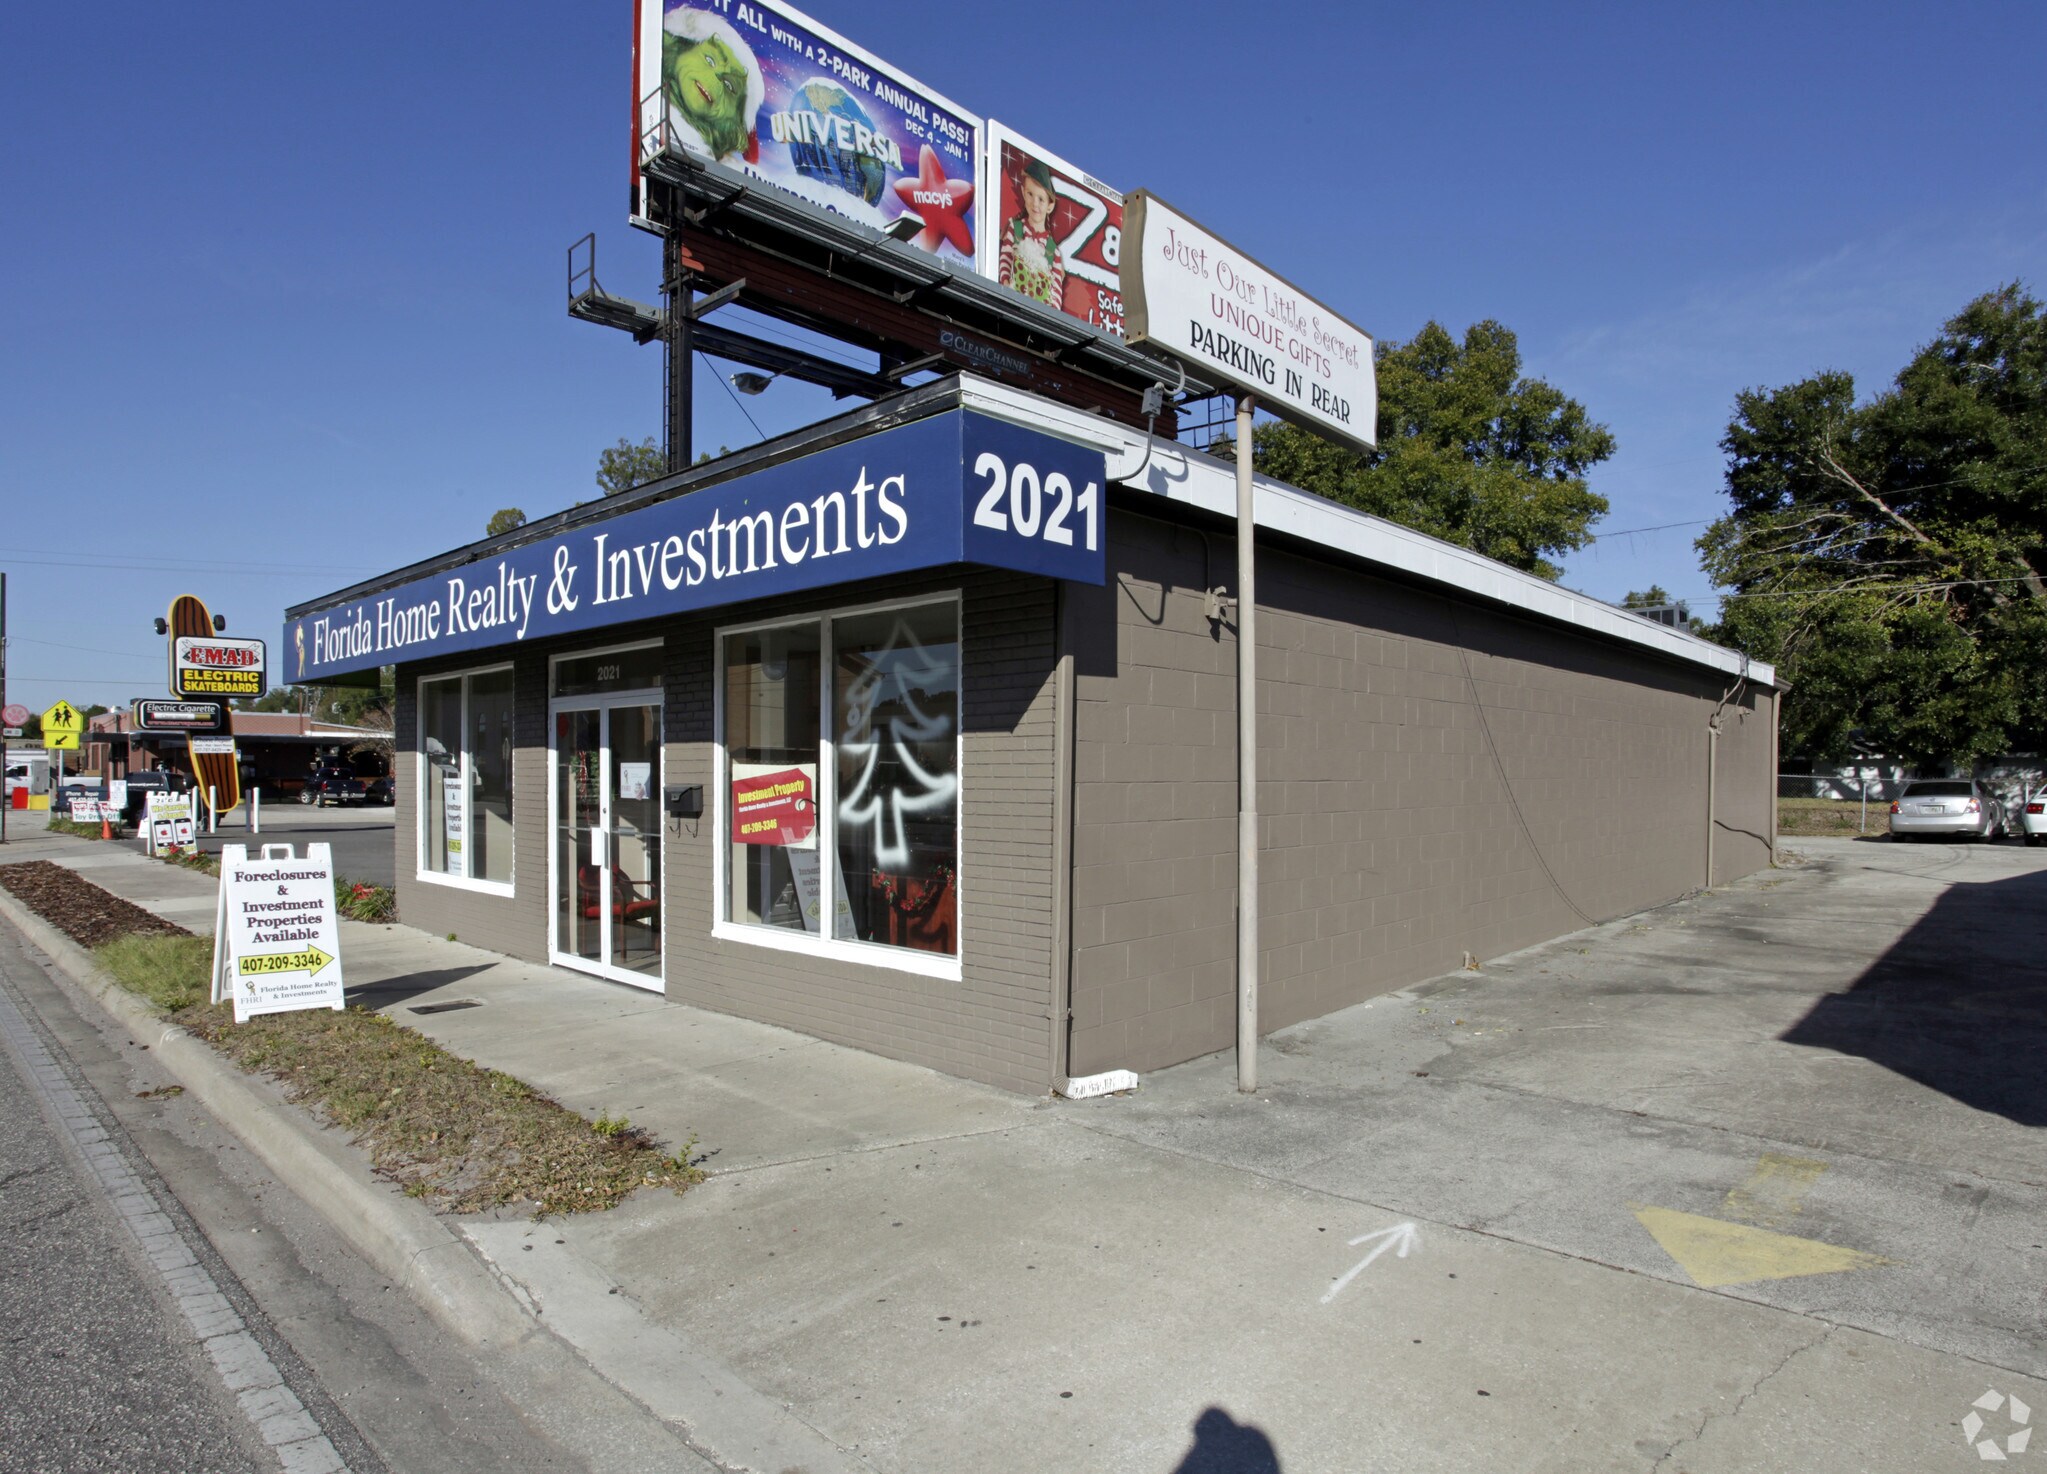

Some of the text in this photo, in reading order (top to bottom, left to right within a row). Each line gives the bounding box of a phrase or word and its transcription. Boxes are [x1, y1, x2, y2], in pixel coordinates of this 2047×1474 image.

[737, 2, 767, 34] ALL
[771, 24, 802, 53] WITH
[805, 45, 814, 60] A
[817, 47, 871, 92] 2-PARK
[874, 80, 929, 124] ANNUAL
[932, 112, 969, 147] PASS!
[905, 118, 924, 138] DEC
[926, 132, 934, 144] 4
[944, 140, 962, 159] JAN
[964, 151, 969, 163] 1
[913, 189, 953, 209] macy's
[1097, 289, 1124, 317] Safe
[1163, 227, 1359, 369] Just Our Little Secret
[1210, 292, 1332, 379] UNIQUE GIFTS
[1190, 319, 1350, 425] PARKING IN REAR
[973, 451, 1098, 552] 2021
[313, 465, 908, 665] Florida Home Realty & Investments
[183, 669, 259, 682] ELECTRIC
[597, 664, 620, 681] 2021
[183, 681, 259, 693] SKATEBOARDS
[147, 703, 216, 713] Electric Cigarette
[738, 780, 805, 804] Investment Property
[234, 869, 327, 883] Foreclosures
[277, 885, 289, 896] &
[242, 898, 324, 913] Investment
[246, 913, 322, 929] Properties
[252, 928, 319, 943] Available
[242, 953, 322, 972] 407-209-3346
[281, 989, 327, 998] Investments
